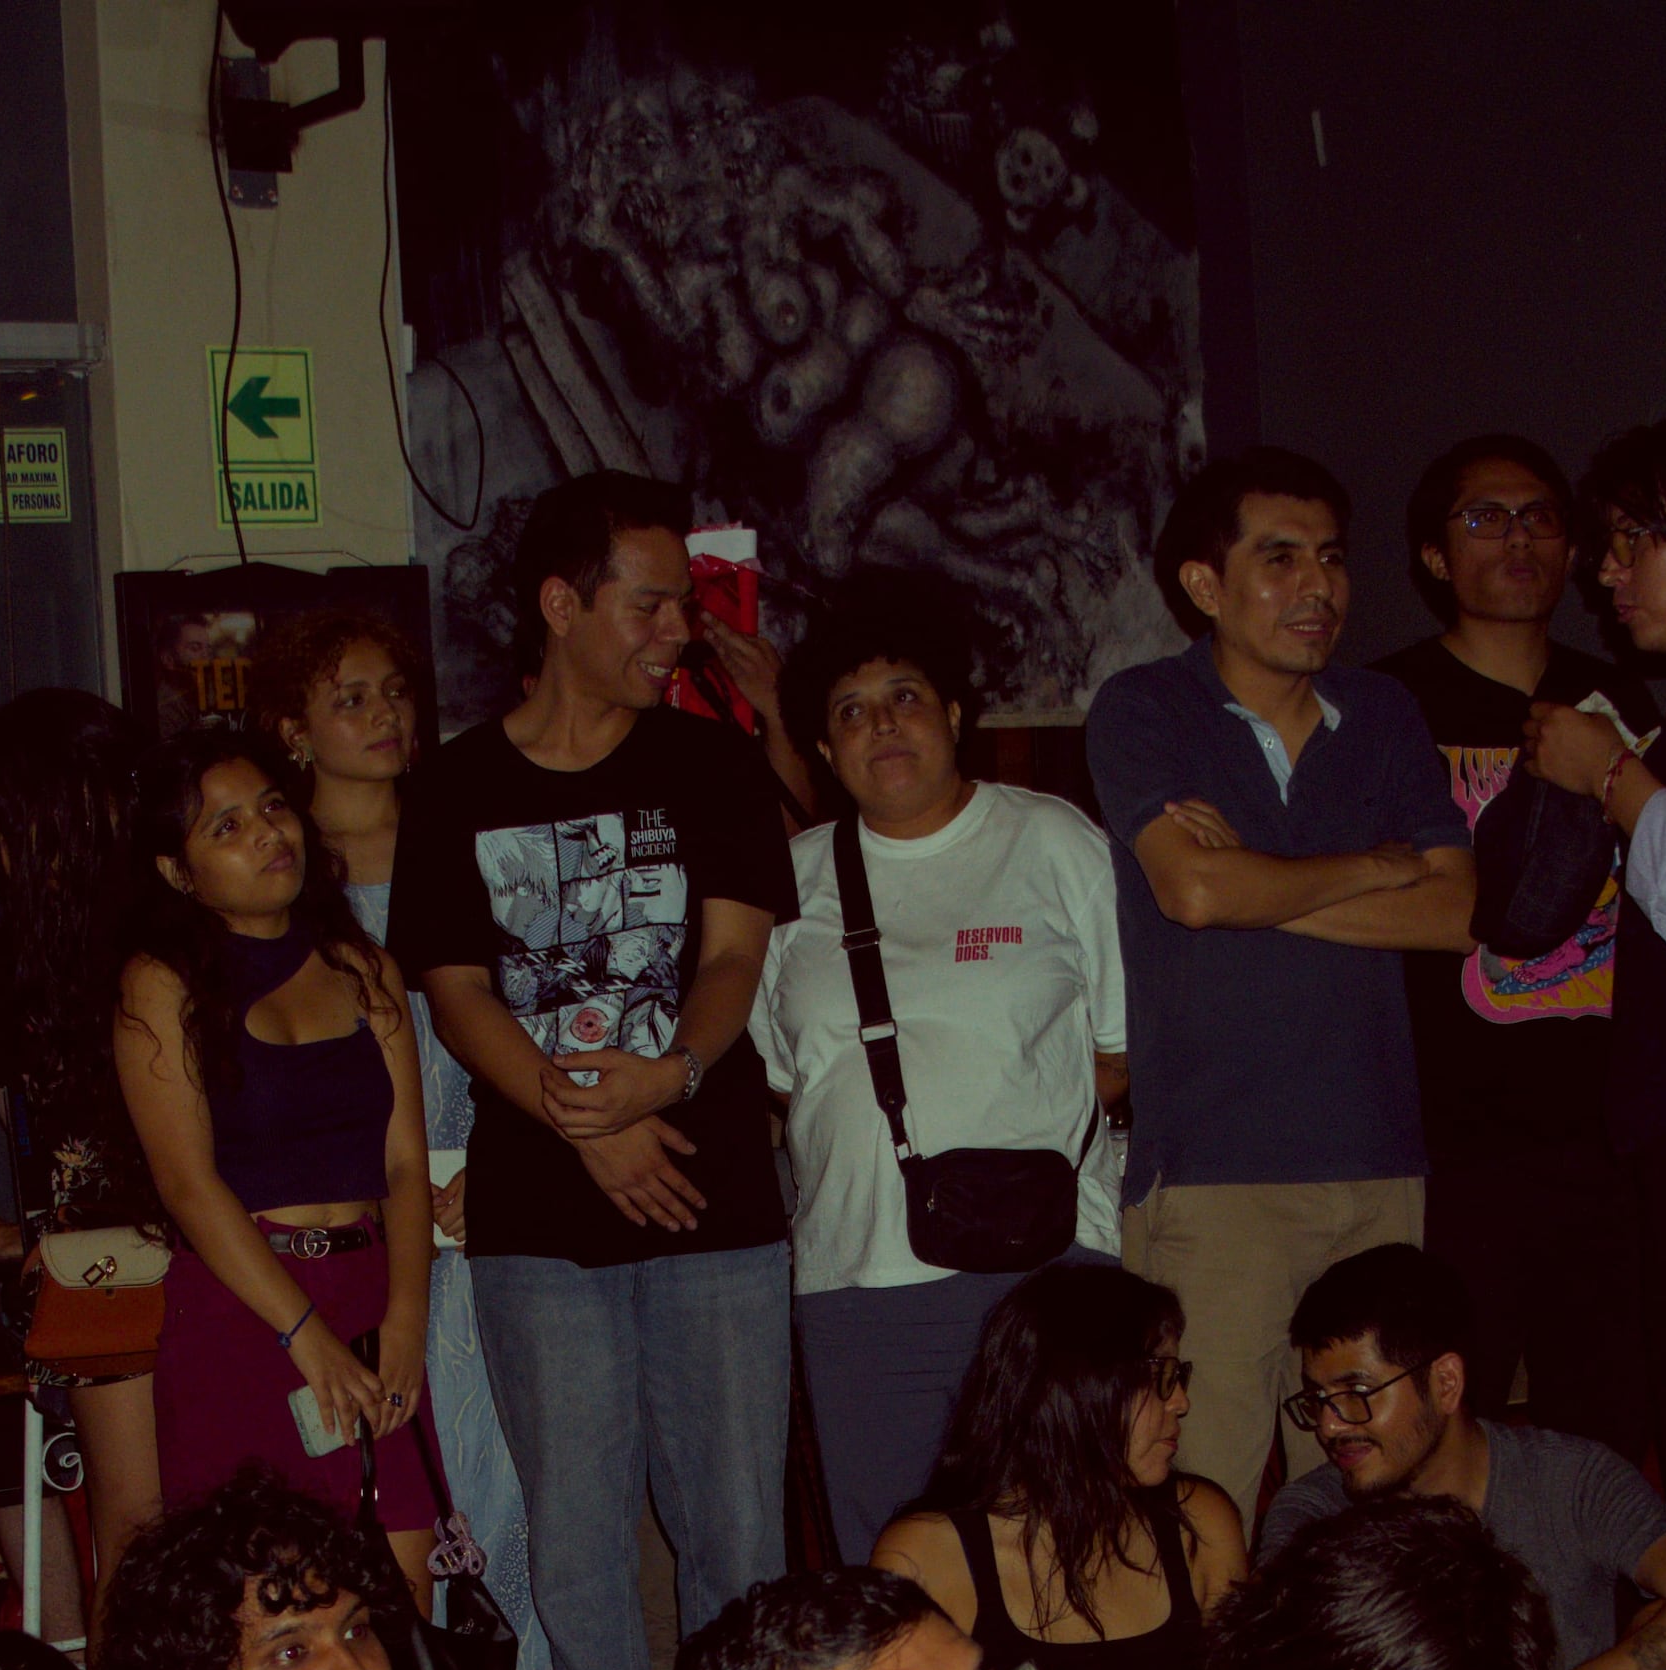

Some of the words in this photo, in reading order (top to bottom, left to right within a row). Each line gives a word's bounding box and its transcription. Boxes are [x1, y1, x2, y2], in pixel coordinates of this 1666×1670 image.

[7, 443, 58, 464] AFORO
[20, 471, 58, 484] MAXIMA
[12, 493, 62, 510] PERSONAS
[228, 482, 309, 511] SALIDA
[637, 808, 668, 829] THE
[630, 827, 676, 846] SHIBUYA
[631, 841, 677, 858] INCIDENT
[956, 926, 1022, 945] RESERVOIR
